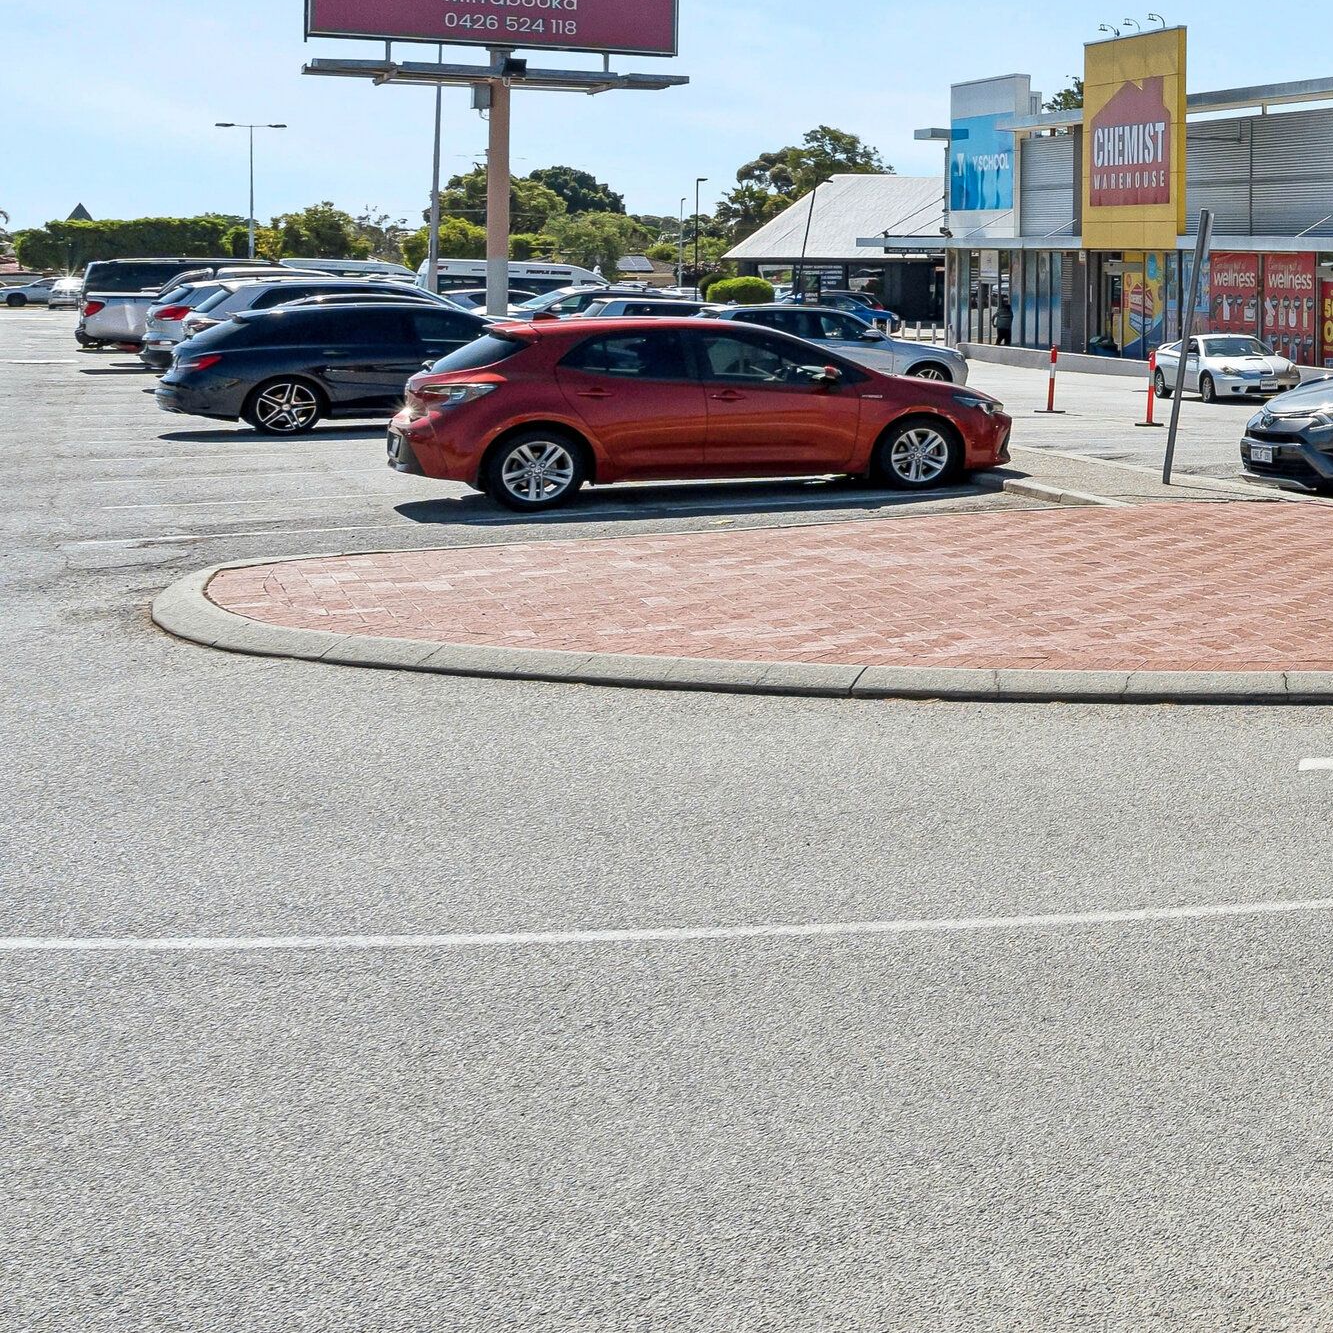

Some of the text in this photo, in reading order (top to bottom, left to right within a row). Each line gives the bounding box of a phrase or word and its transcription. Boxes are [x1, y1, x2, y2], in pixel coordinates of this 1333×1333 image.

[444, 12, 577, 35] 0426 524 118
[1093, 122, 1166, 168] CHEMIST
[1093, 170, 1165, 190] WAREHOUSE
[1213, 268, 1256, 288] wellness
[1268, 269, 1313, 290] wellness
